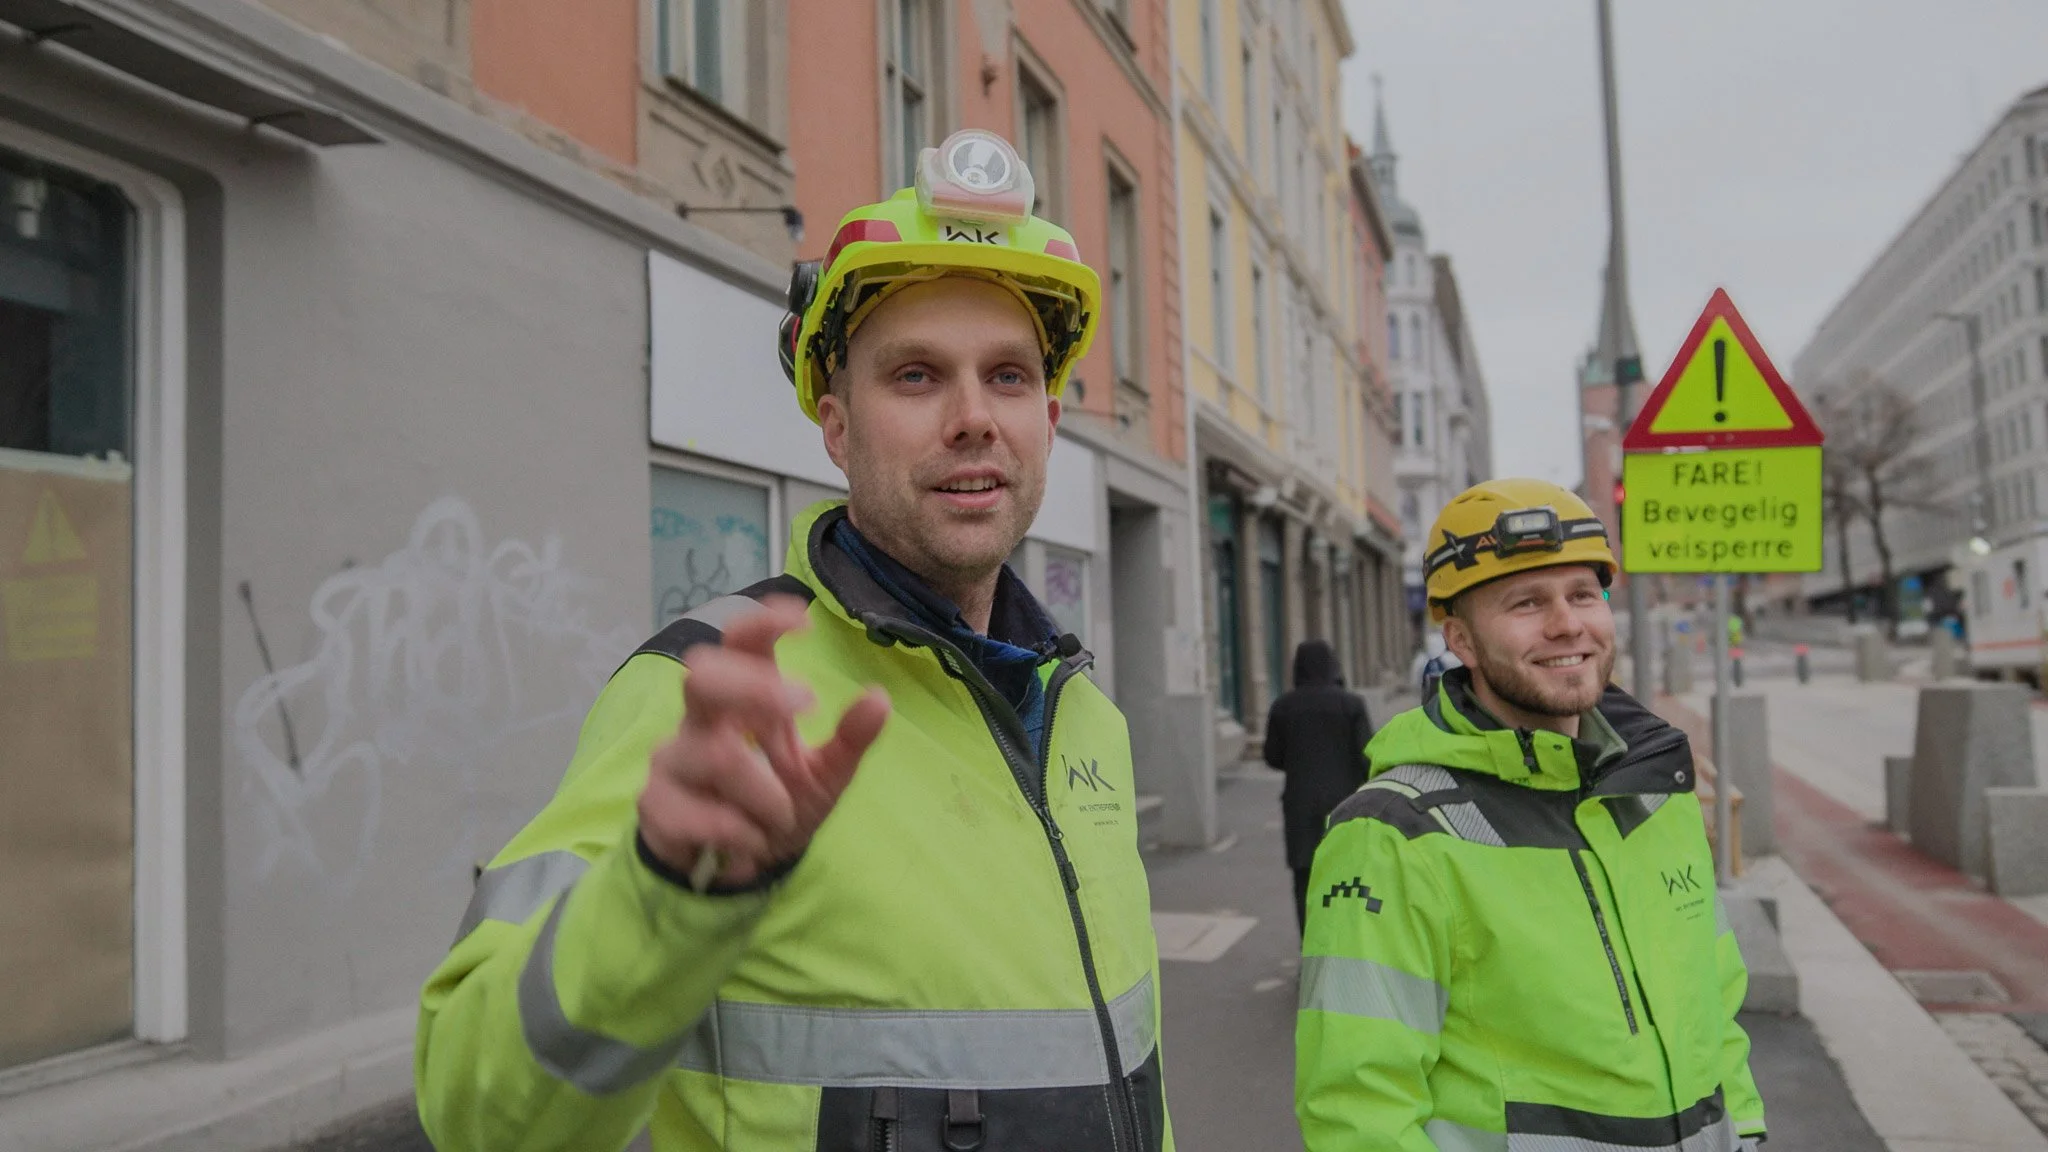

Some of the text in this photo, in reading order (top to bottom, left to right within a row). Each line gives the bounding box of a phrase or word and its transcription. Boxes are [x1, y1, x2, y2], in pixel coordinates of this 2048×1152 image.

[1672, 460, 1763, 487] FARE!
[1643, 497, 1799, 528] Bevegelig
[1650, 534, 1794, 562] veisperre
